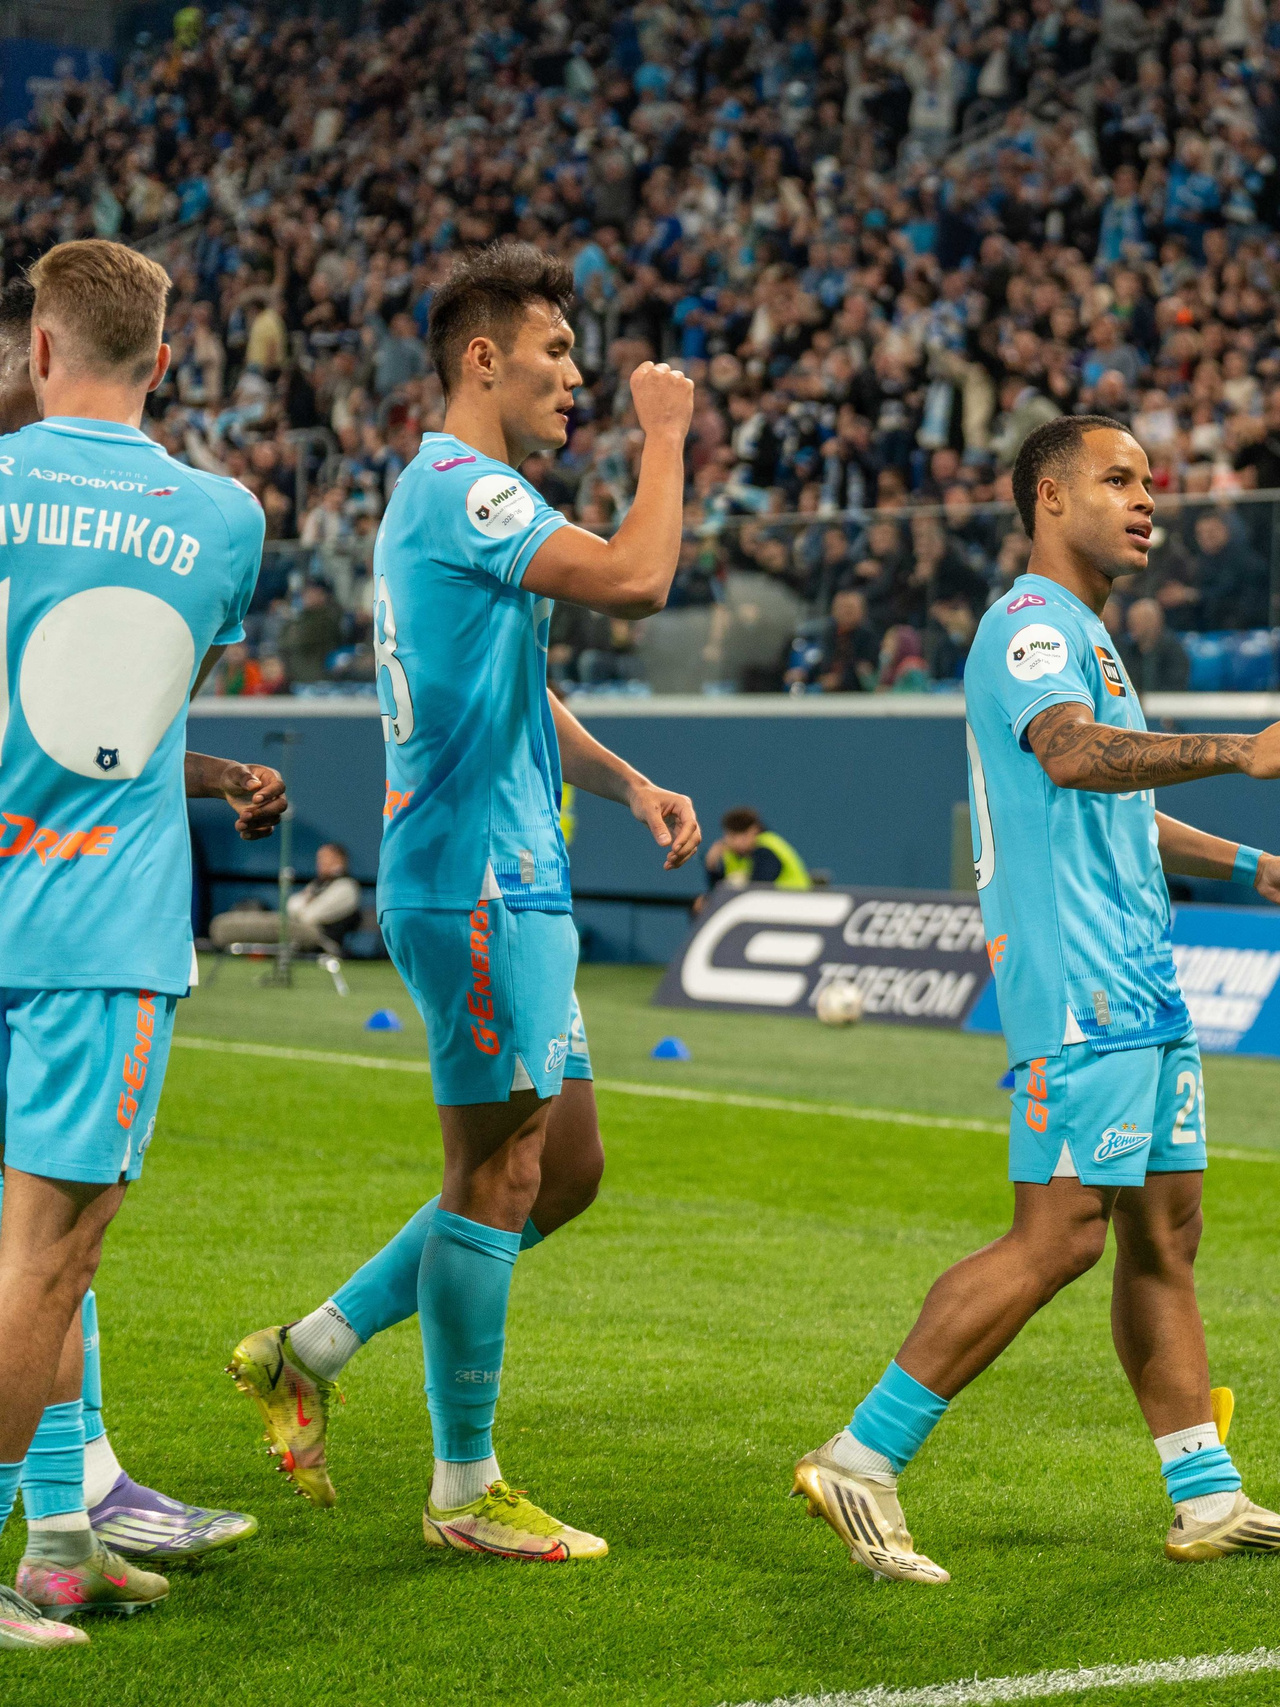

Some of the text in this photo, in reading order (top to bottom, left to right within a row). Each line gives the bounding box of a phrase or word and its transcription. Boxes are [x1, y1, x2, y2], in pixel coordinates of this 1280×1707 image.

[27, 467, 147, 493] АЭРОФЛОТ
[102, 469, 149, 481] ГРУППА
[490, 485, 518, 507] МИР
[1029, 641, 1061, 651] МИР
